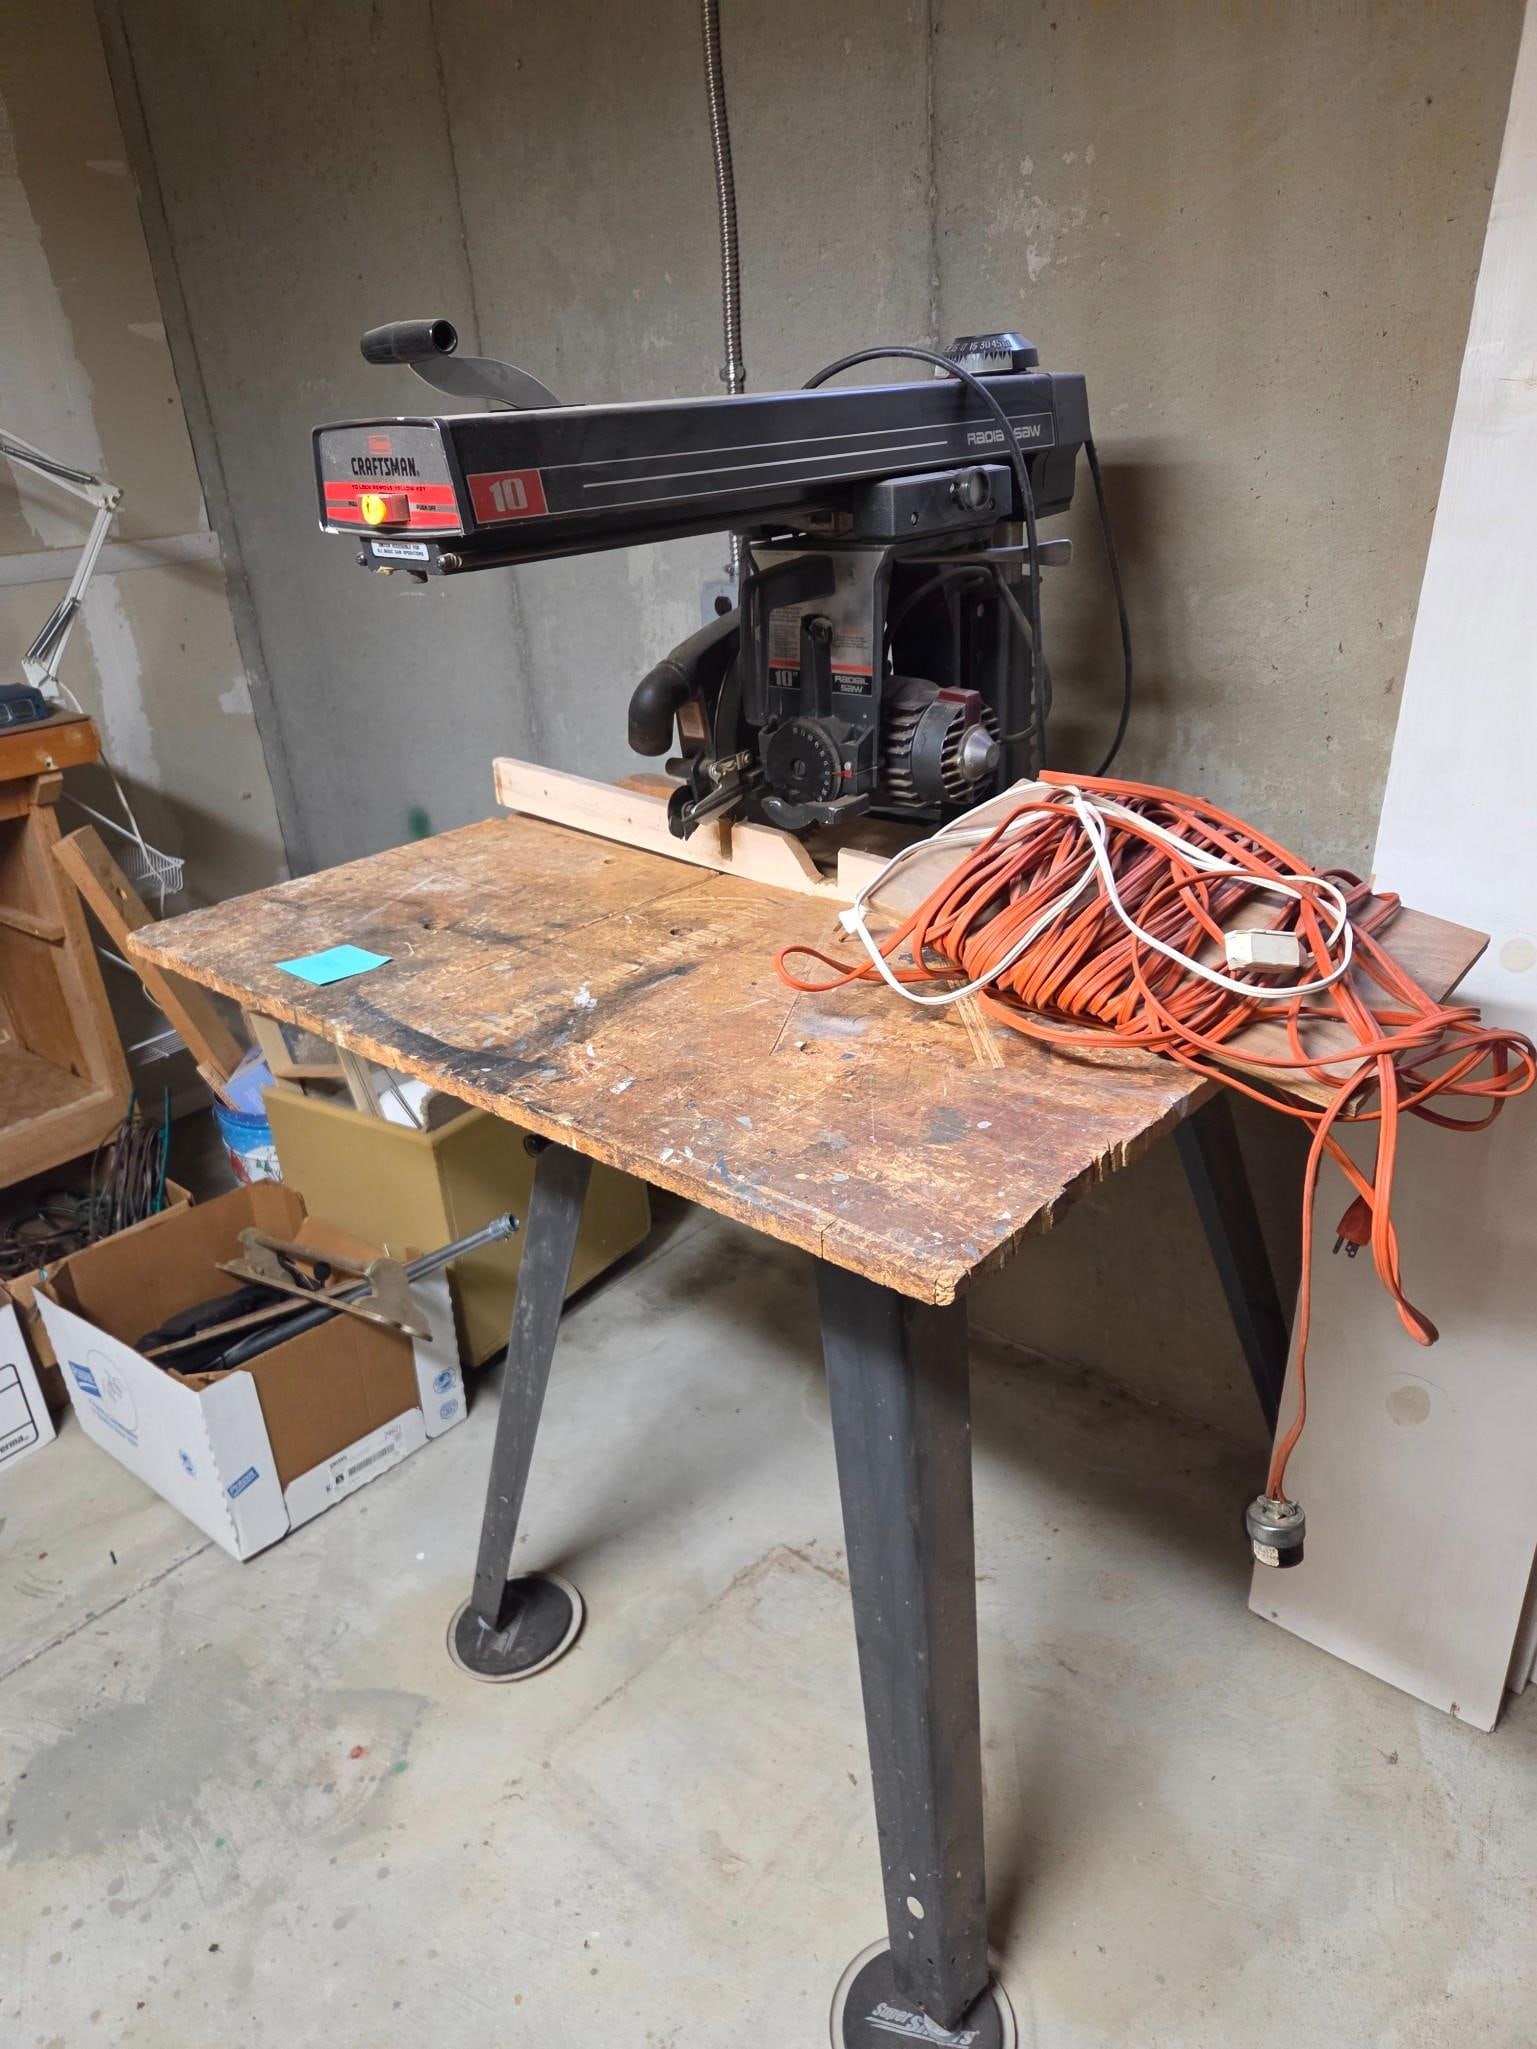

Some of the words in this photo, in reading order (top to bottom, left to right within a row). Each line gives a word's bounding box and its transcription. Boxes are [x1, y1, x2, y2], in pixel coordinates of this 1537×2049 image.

[980, 341, 991, 350] 30
[992, 340, 1002, 348] 45
[351, 457, 417, 477] CRAFTSMAN
[489, 478, 528, 512] 10
